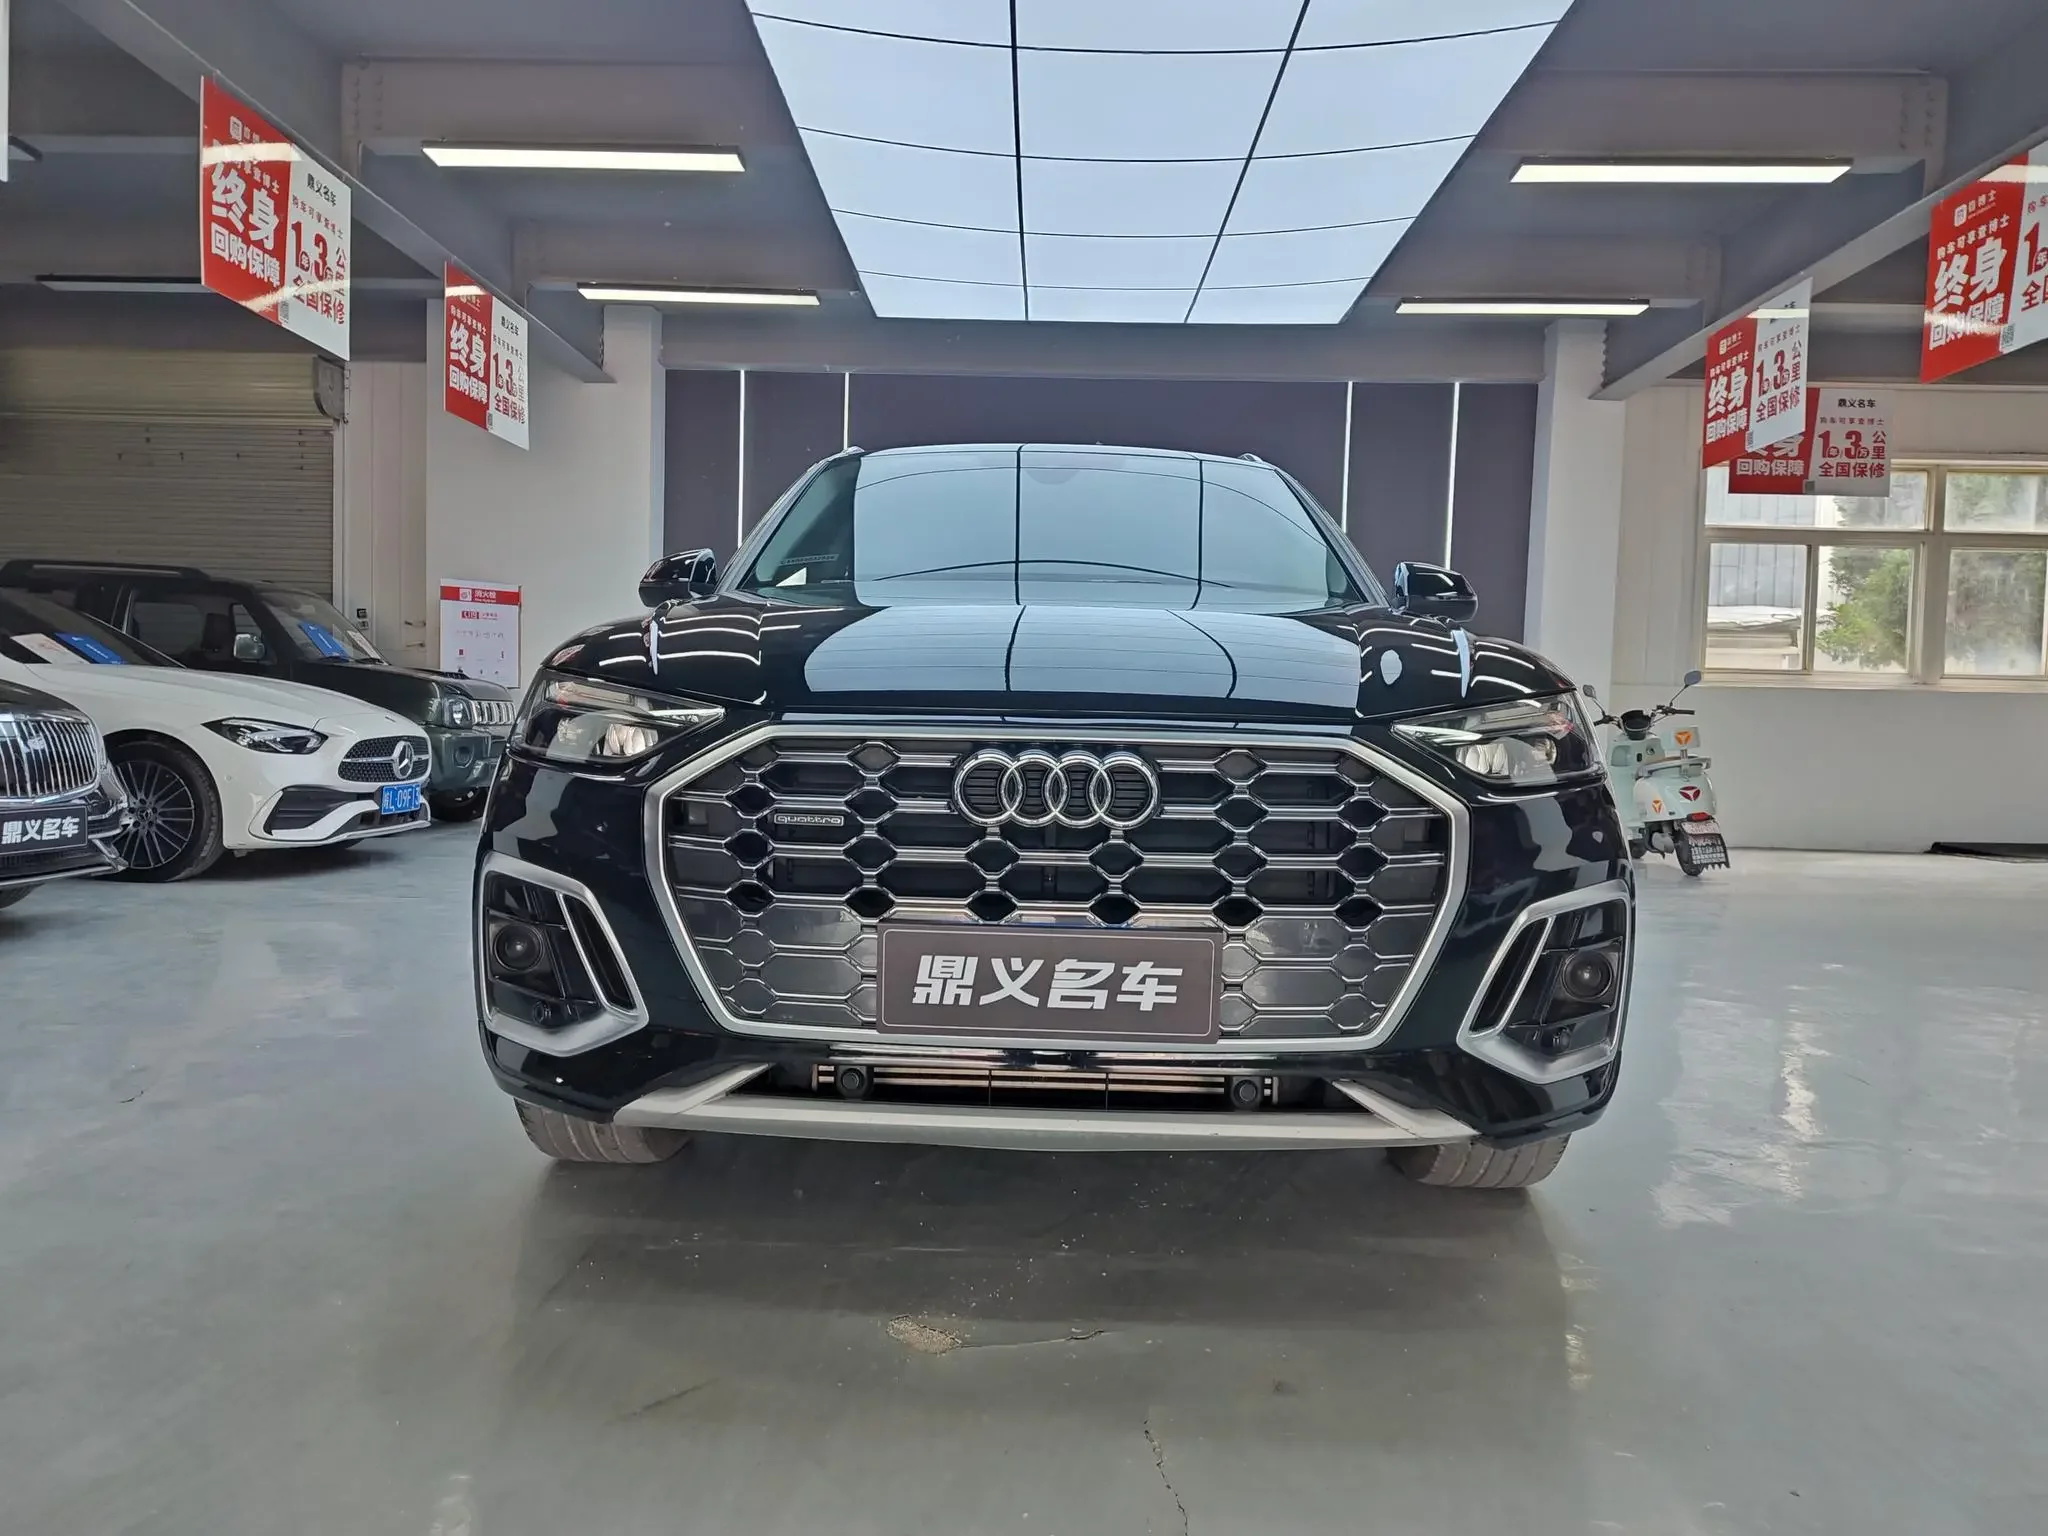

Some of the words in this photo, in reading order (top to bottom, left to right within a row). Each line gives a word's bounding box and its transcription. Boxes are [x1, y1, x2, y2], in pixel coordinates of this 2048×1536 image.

[212, 161, 279, 250] 终身
[307, 173, 336, 207] 鼎义名车
[211, 221, 281, 288] 回购保障
[1932, 236, 2007, 313] 终身
[450, 318, 487, 378] 终身
[449, 364, 488, 406] 回购保障
[1707, 365, 1748, 419] 终身
[1756, 385, 1800, 423] 全国保修
[1838, 398, 1876, 409] 鼎义名车
[1706, 407, 1748, 445] 回购保障
[1736, 458, 1804, 476] 回购保障
[1819, 461, 1885, 478] 全国保修
[1, 815, 80, 845] 鼎义名车
[777, 815, 841, 824] quattro
[912, 954, 1184, 1012] 鼎义名车
